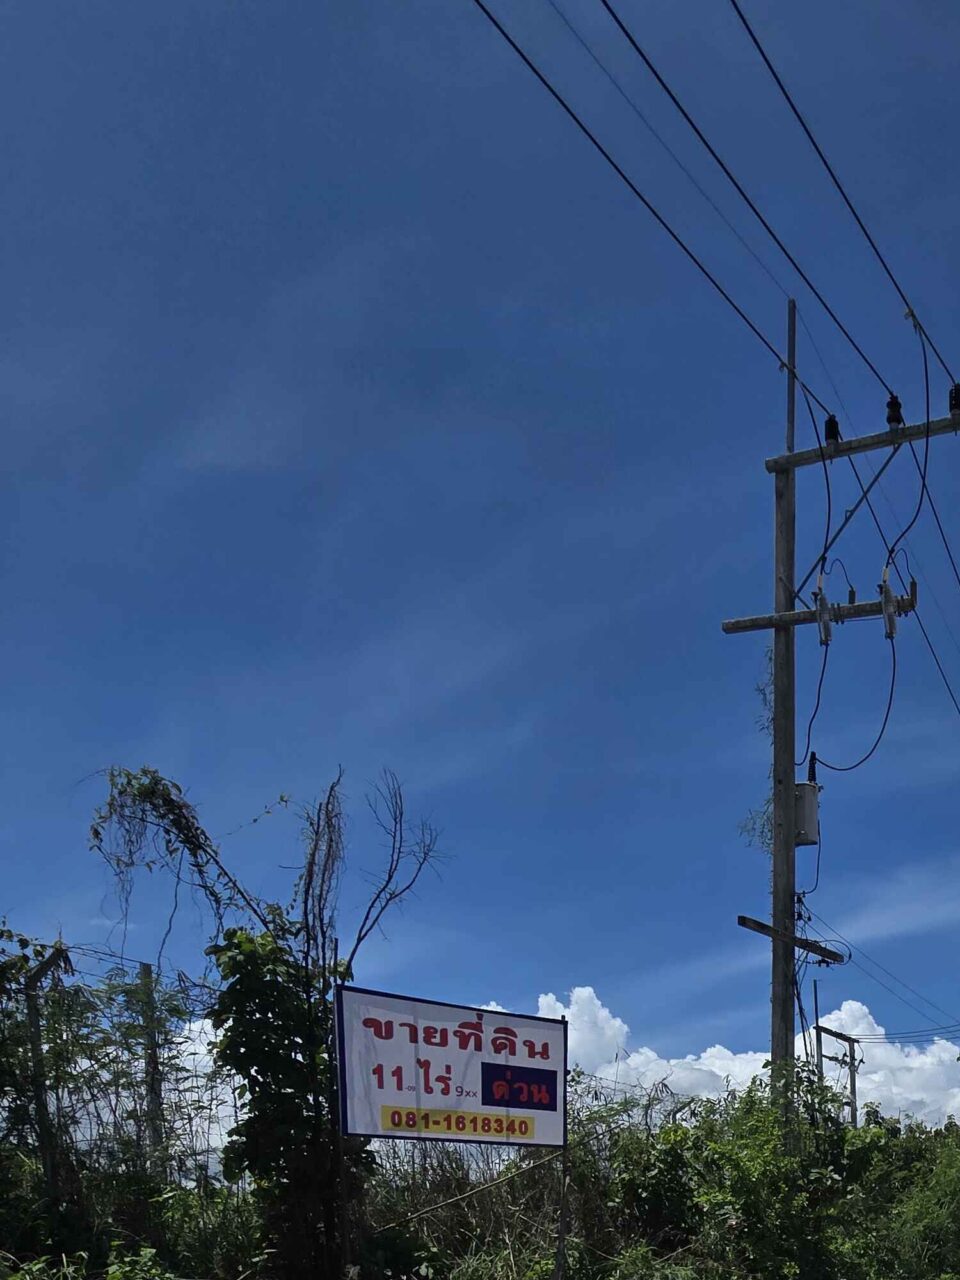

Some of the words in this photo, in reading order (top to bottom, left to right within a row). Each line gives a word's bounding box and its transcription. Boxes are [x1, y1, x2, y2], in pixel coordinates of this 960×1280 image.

[362, 1013, 551, 1060] ขายที่ดิน
[372, 1063, 403, 1092] 11
[416, 1058, 453, 1097] ไร่
[491, 1070, 550, 1105] ด่วน
[390, 1110, 529, 1136] 081-1618340
